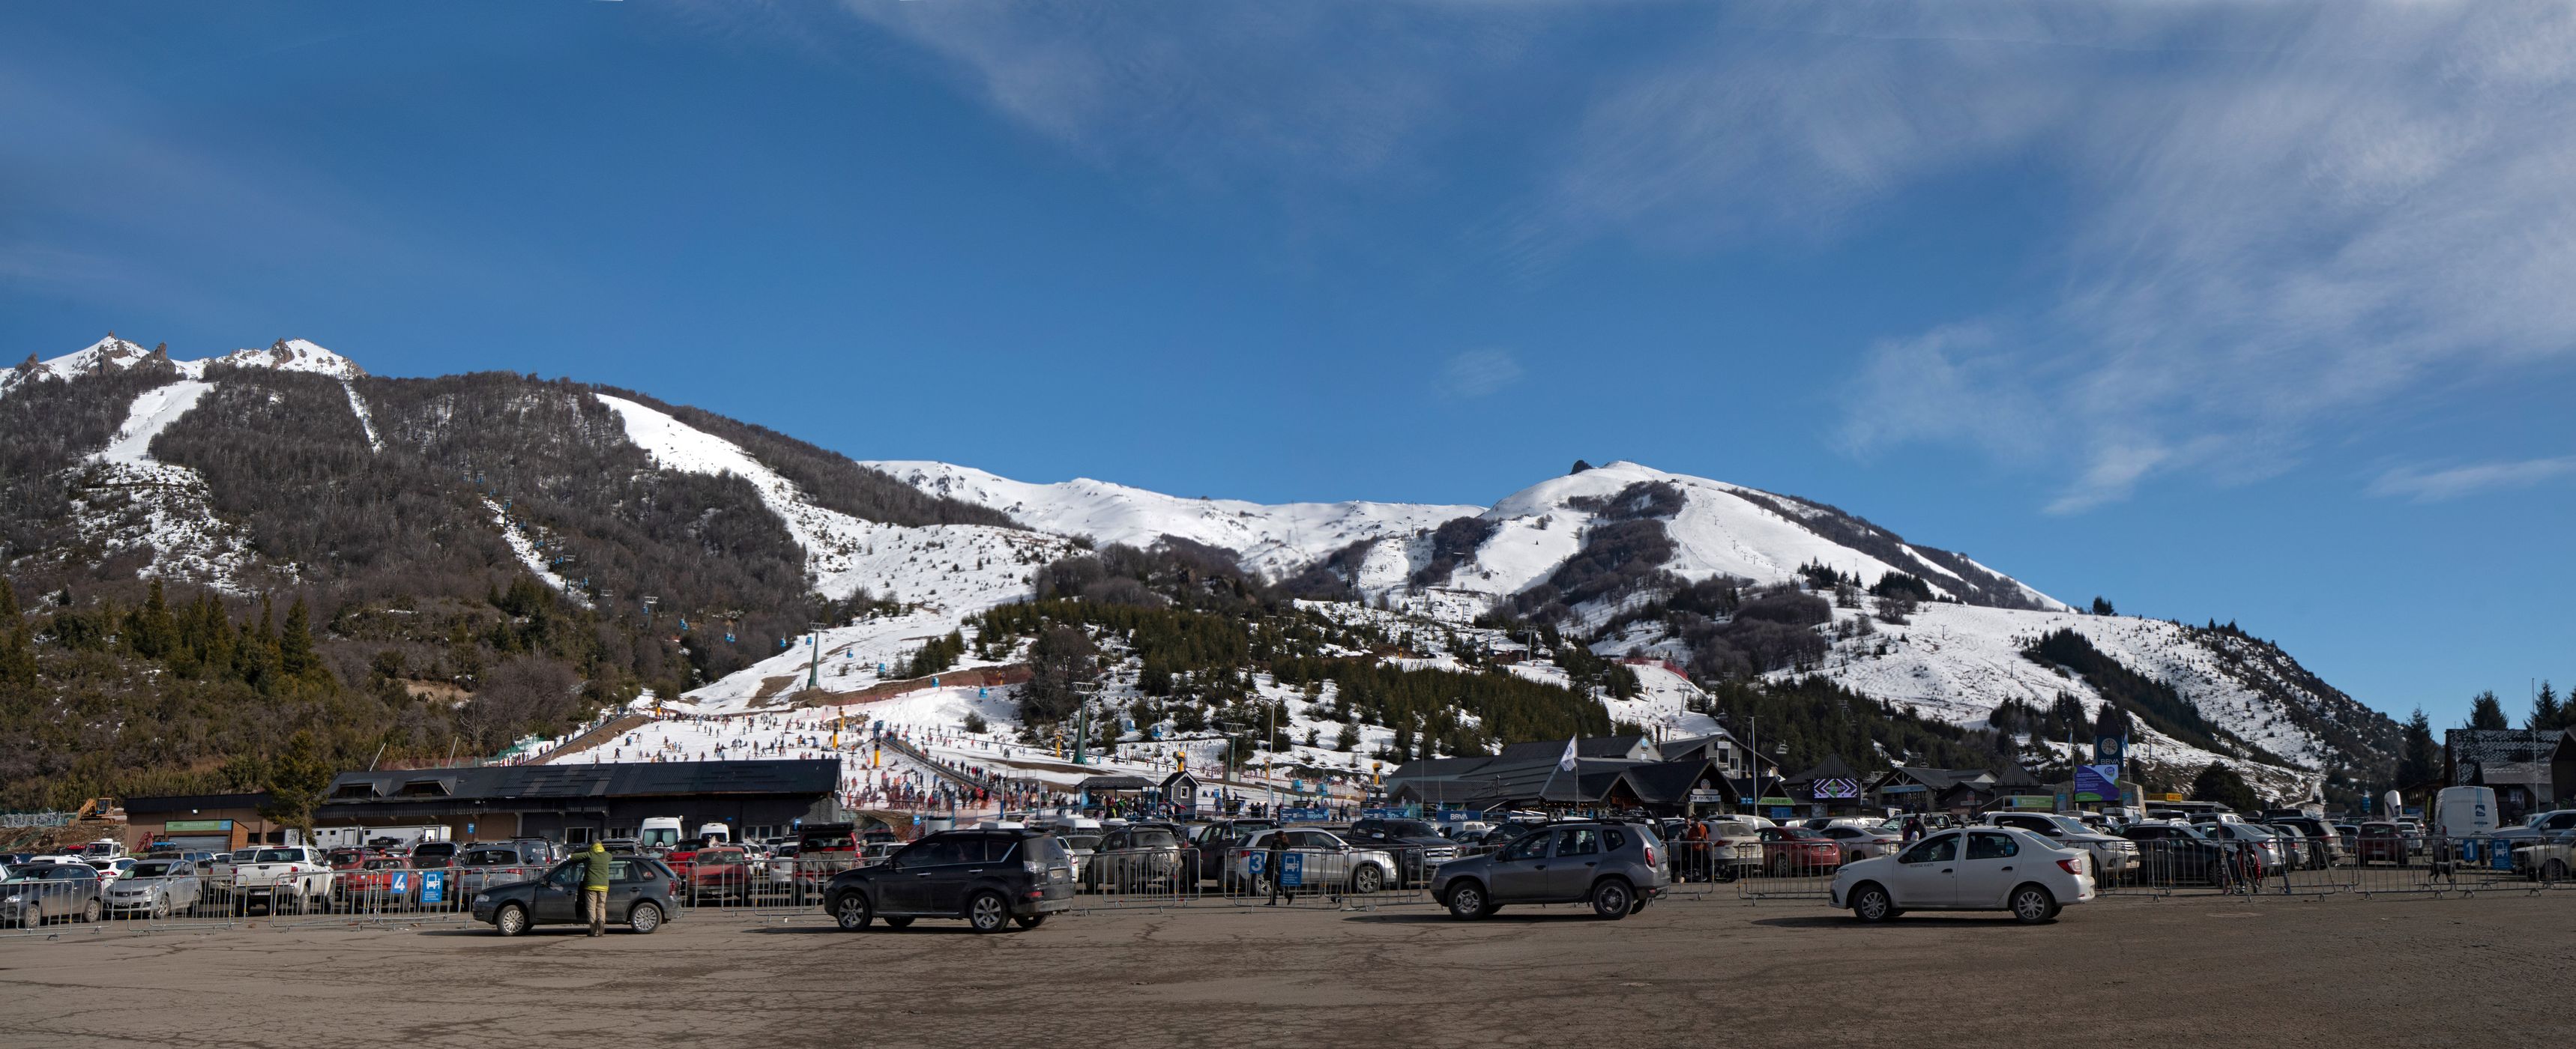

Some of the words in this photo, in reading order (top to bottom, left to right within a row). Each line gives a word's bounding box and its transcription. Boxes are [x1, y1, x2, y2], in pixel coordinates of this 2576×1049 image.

[2466, 841, 2473, 858] 1
[1251, 854, 1263, 871] 3
[393, 874, 405, 891] 4
